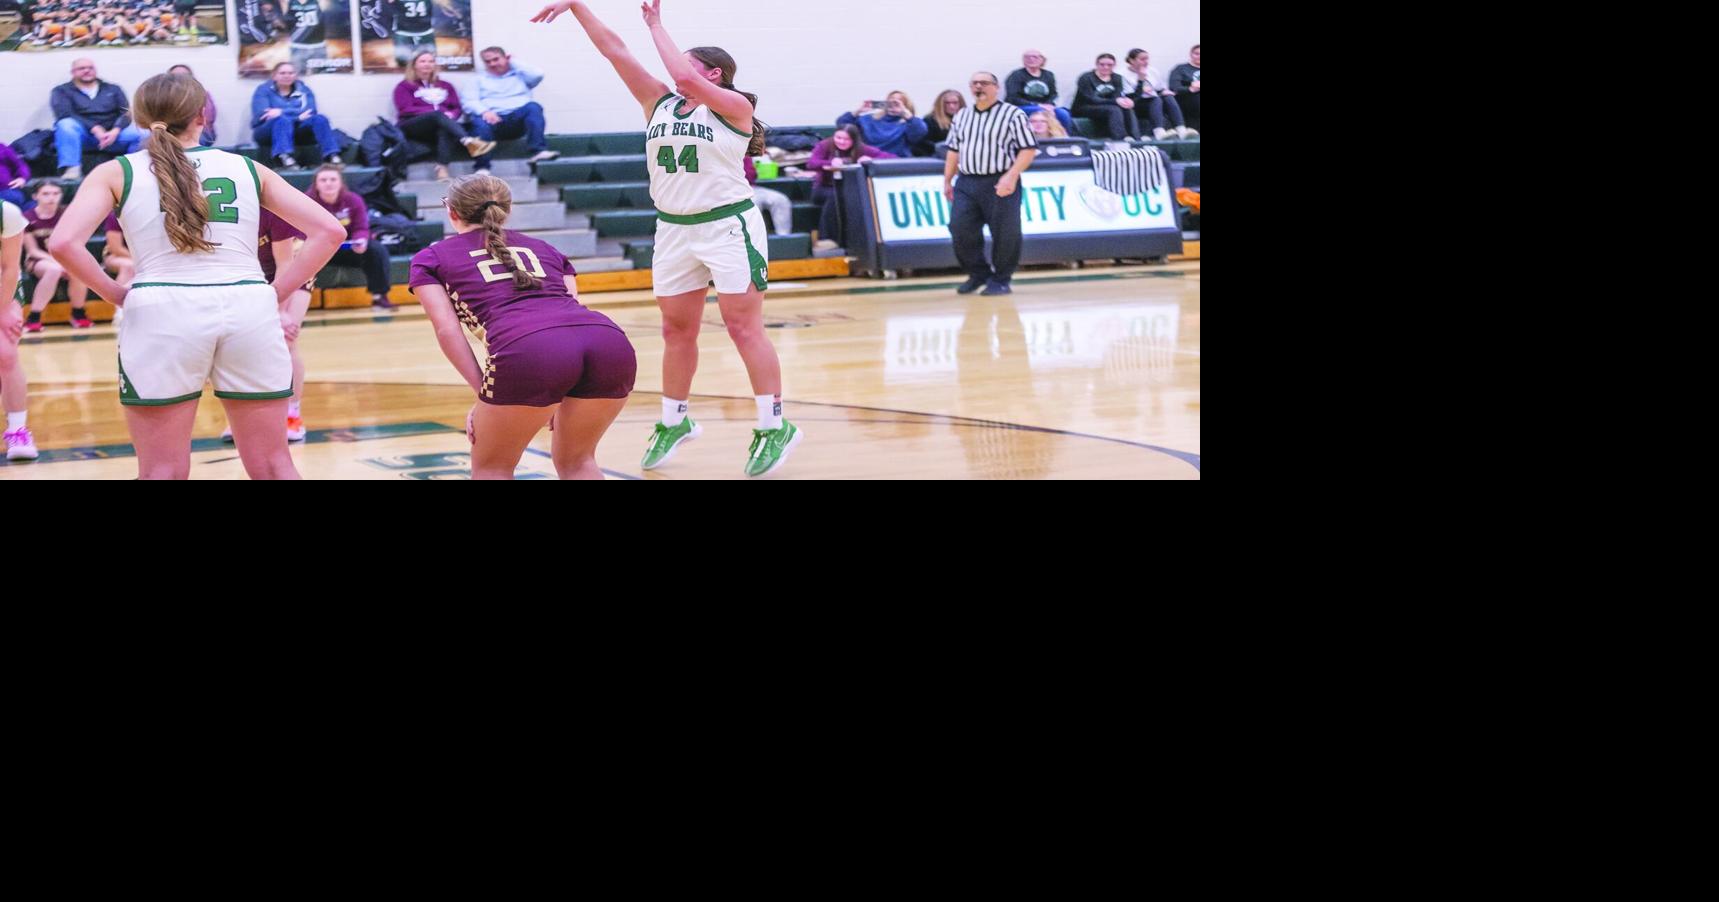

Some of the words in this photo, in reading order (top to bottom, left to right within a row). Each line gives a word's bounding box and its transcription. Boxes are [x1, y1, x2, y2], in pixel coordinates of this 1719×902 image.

[404, 1, 427, 17] 34
[672, 122, 714, 142] BEARS
[657, 145, 699, 173] 44
[469, 246, 547, 283] 20
